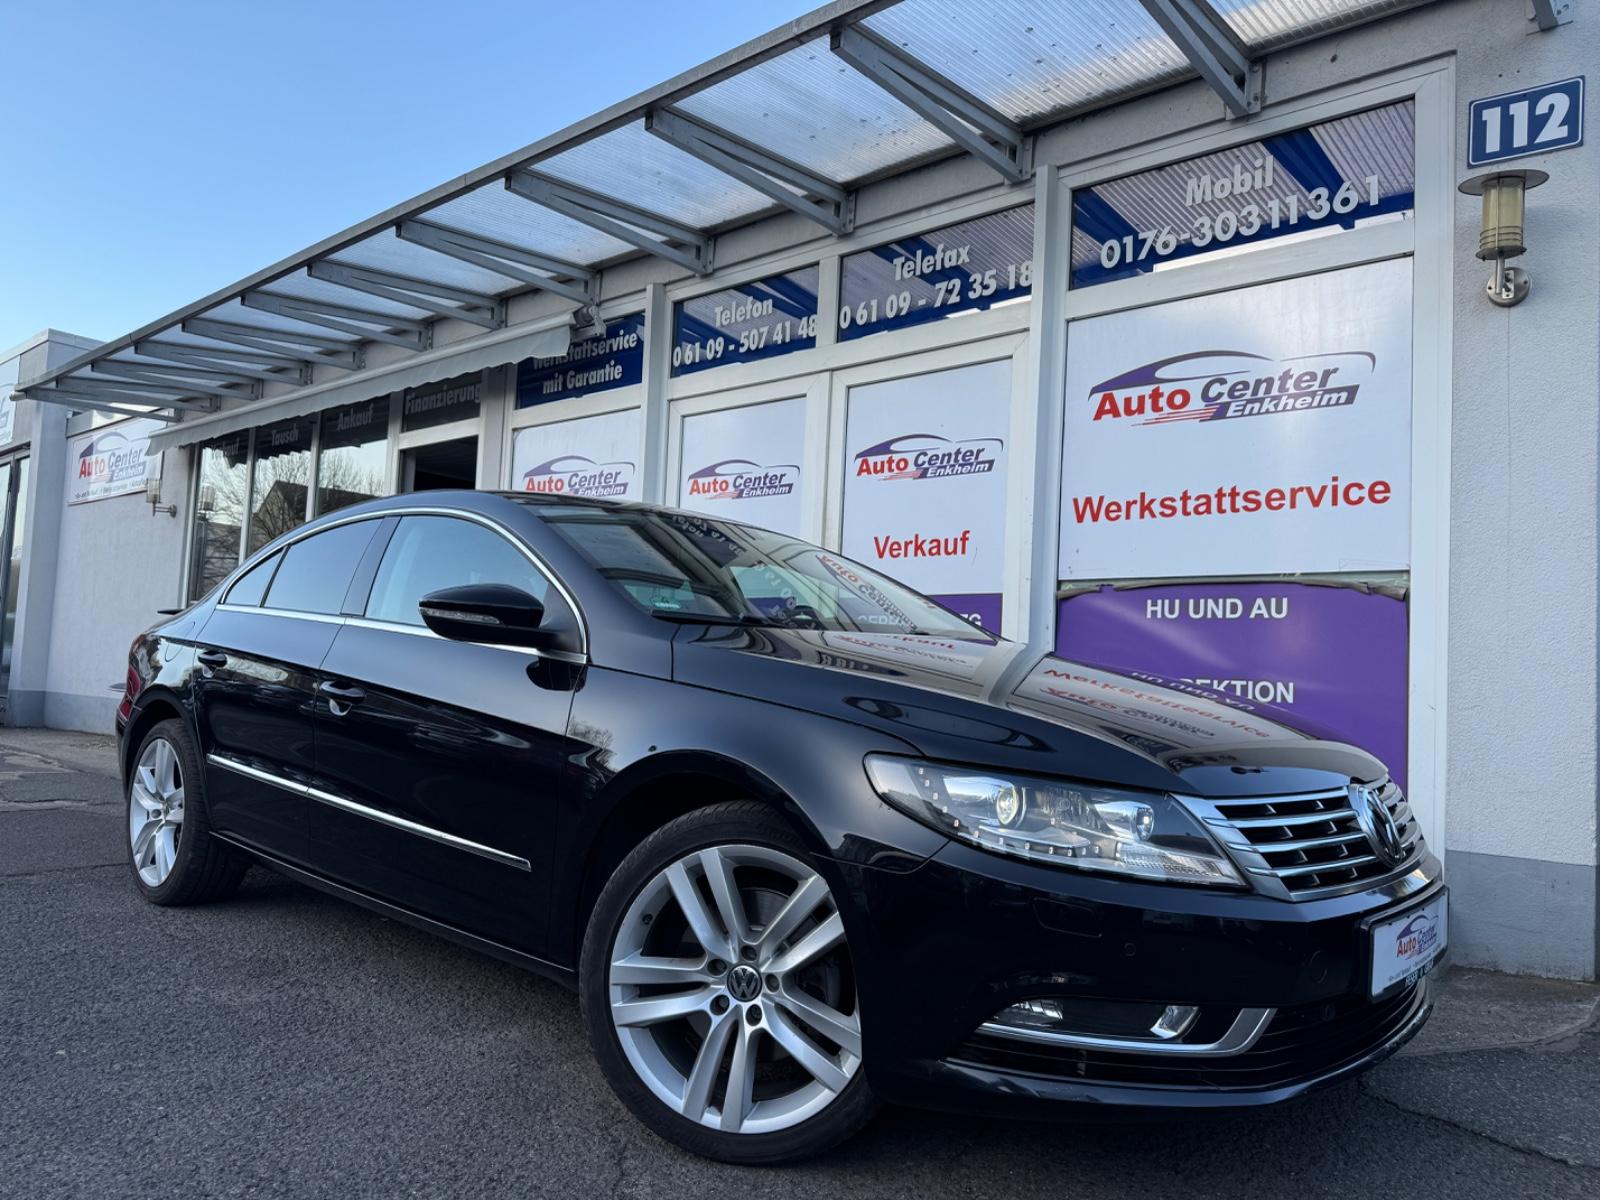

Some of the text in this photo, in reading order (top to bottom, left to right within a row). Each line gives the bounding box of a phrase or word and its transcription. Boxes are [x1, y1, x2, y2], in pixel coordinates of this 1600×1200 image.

[1482, 93, 1570, 154] 112
[1185, 155, 1274, 207] Mobil
[892, 243, 970, 281] Telefax
[714, 295, 773, 327] Telefon
[543, 360, 622, 394] mit Garantie
[404, 383, 481, 415] Finanzierung
[1092, 367, 1340, 421] Auto Center
[1225, 390, 1348, 418] Enkheim
[336, 404, 374, 431] Ankauf
[271, 423, 299, 447] Tausch
[79, 448, 142, 480] Auto Center
[856, 447, 986, 477] Auto Center
[926, 462, 989, 478] Enkheim
[526, 469, 622, 492] Auto Center
[689, 471, 785, 497] Auto Center
[742, 484, 789, 498] Enkheim
[1072, 476, 1391, 523] Werkstattservice
[873, 530, 971, 559] Verkauf
[1146, 597, 1288, 619] HU UND AU
